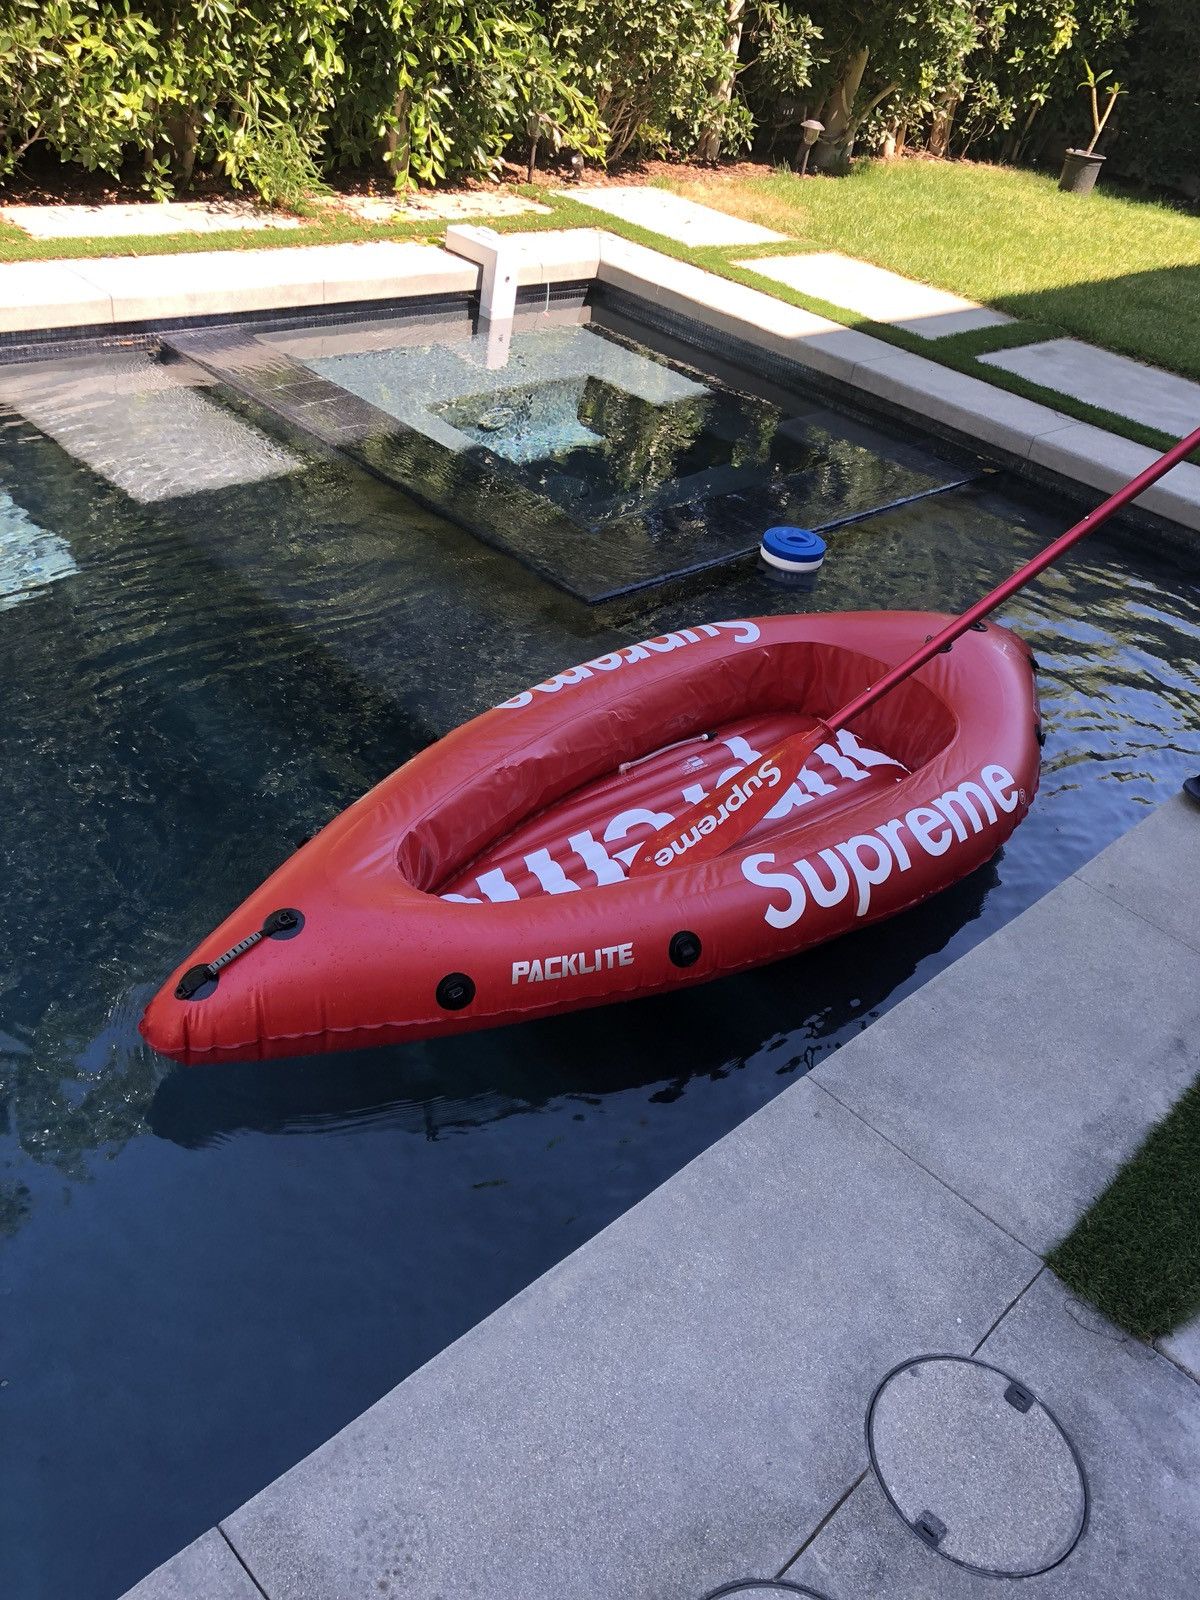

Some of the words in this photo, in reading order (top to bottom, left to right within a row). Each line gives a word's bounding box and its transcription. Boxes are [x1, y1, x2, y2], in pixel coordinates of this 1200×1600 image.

[652, 759, 782, 867] Supreme
[741, 764, 1019, 929] Supreme
[511, 942, 634, 984] PACKLITE
